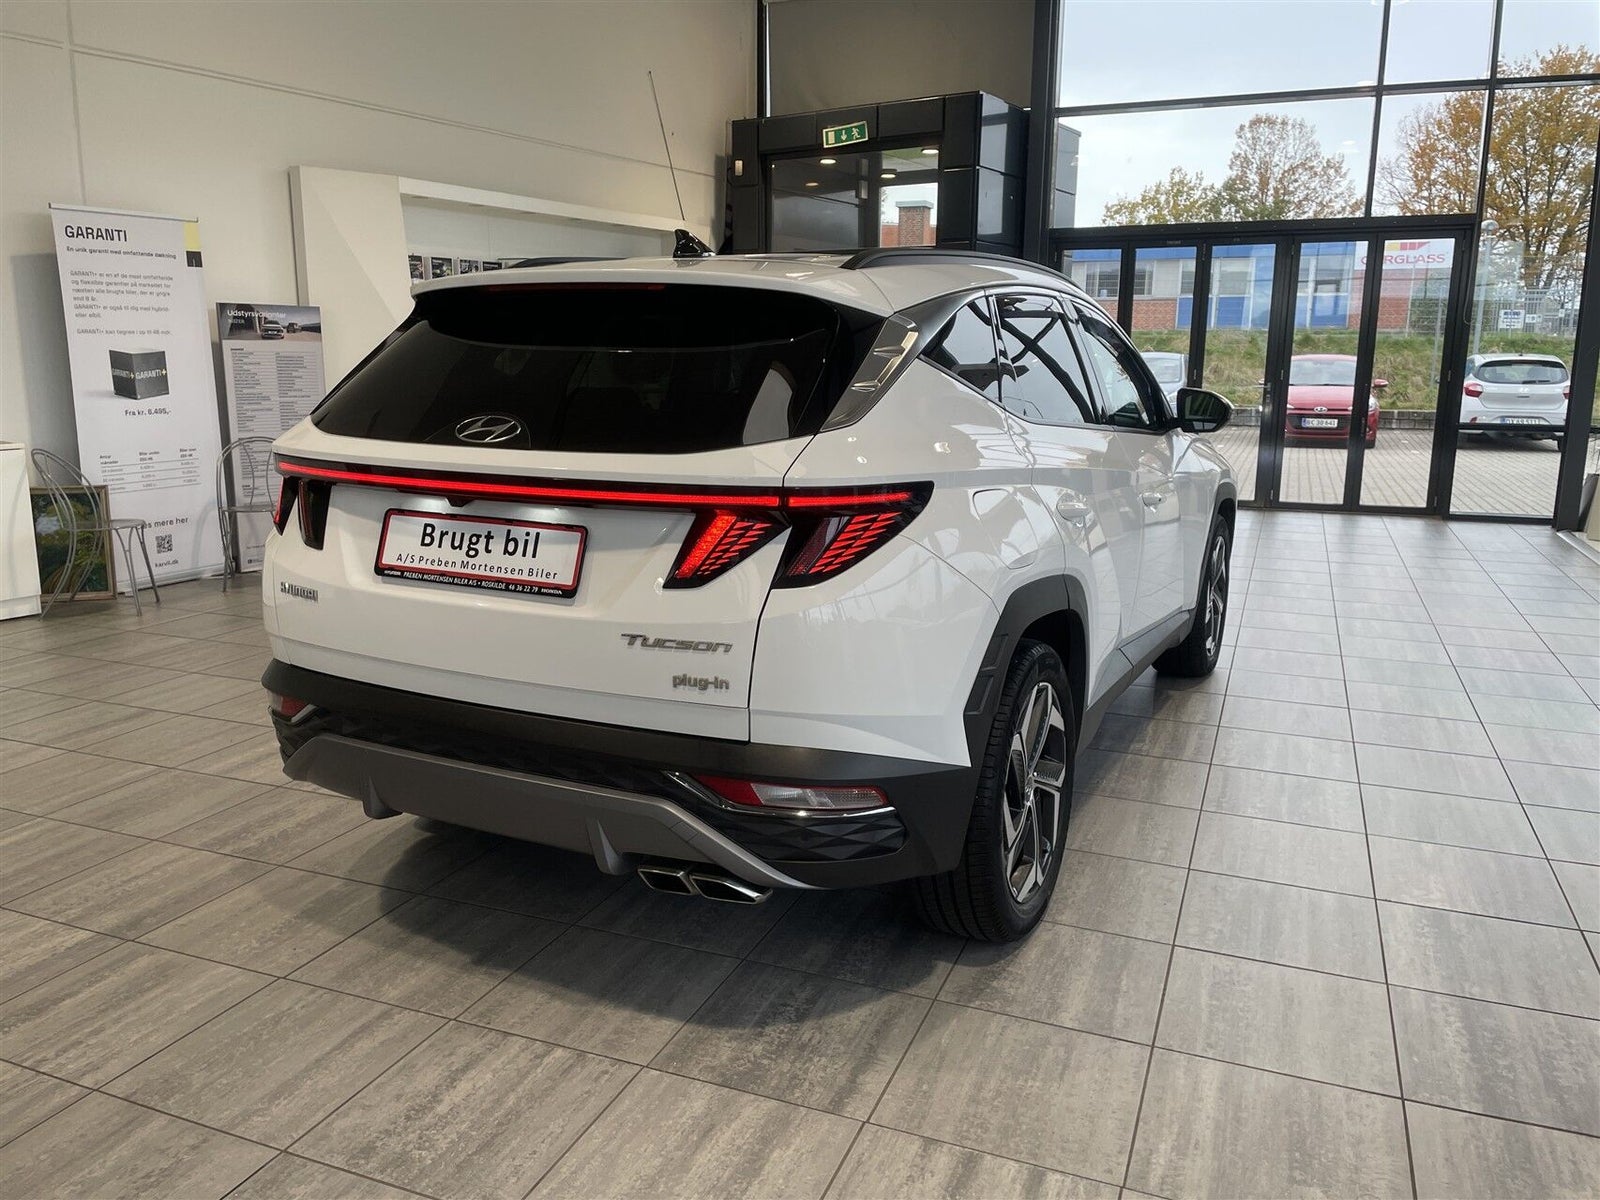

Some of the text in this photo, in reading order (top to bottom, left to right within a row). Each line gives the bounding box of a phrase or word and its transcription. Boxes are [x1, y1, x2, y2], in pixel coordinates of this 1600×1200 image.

[64, 225, 127, 242] GARANTI
[122, 250, 154, 258] omfattende
[154, 252, 176, 260] dækning
[1361, 253, 1445, 264] CRGLASS
[154, 520, 174, 528] mere
[175, 517, 188, 525] her
[420, 523, 540, 559] Brugt bil
[396, 553, 558, 580] A/S Preben Mortensen Biler
[403, 571, 422, 580] PREBEN
[423, 574, 453, 583] MORTENSEN
[453, 577, 468, 585] BILER
[480, 580, 506, 590] ROSKILDE
[621, 633, 733, 653] Tucson
[672, 674, 729, 691] plug-in
